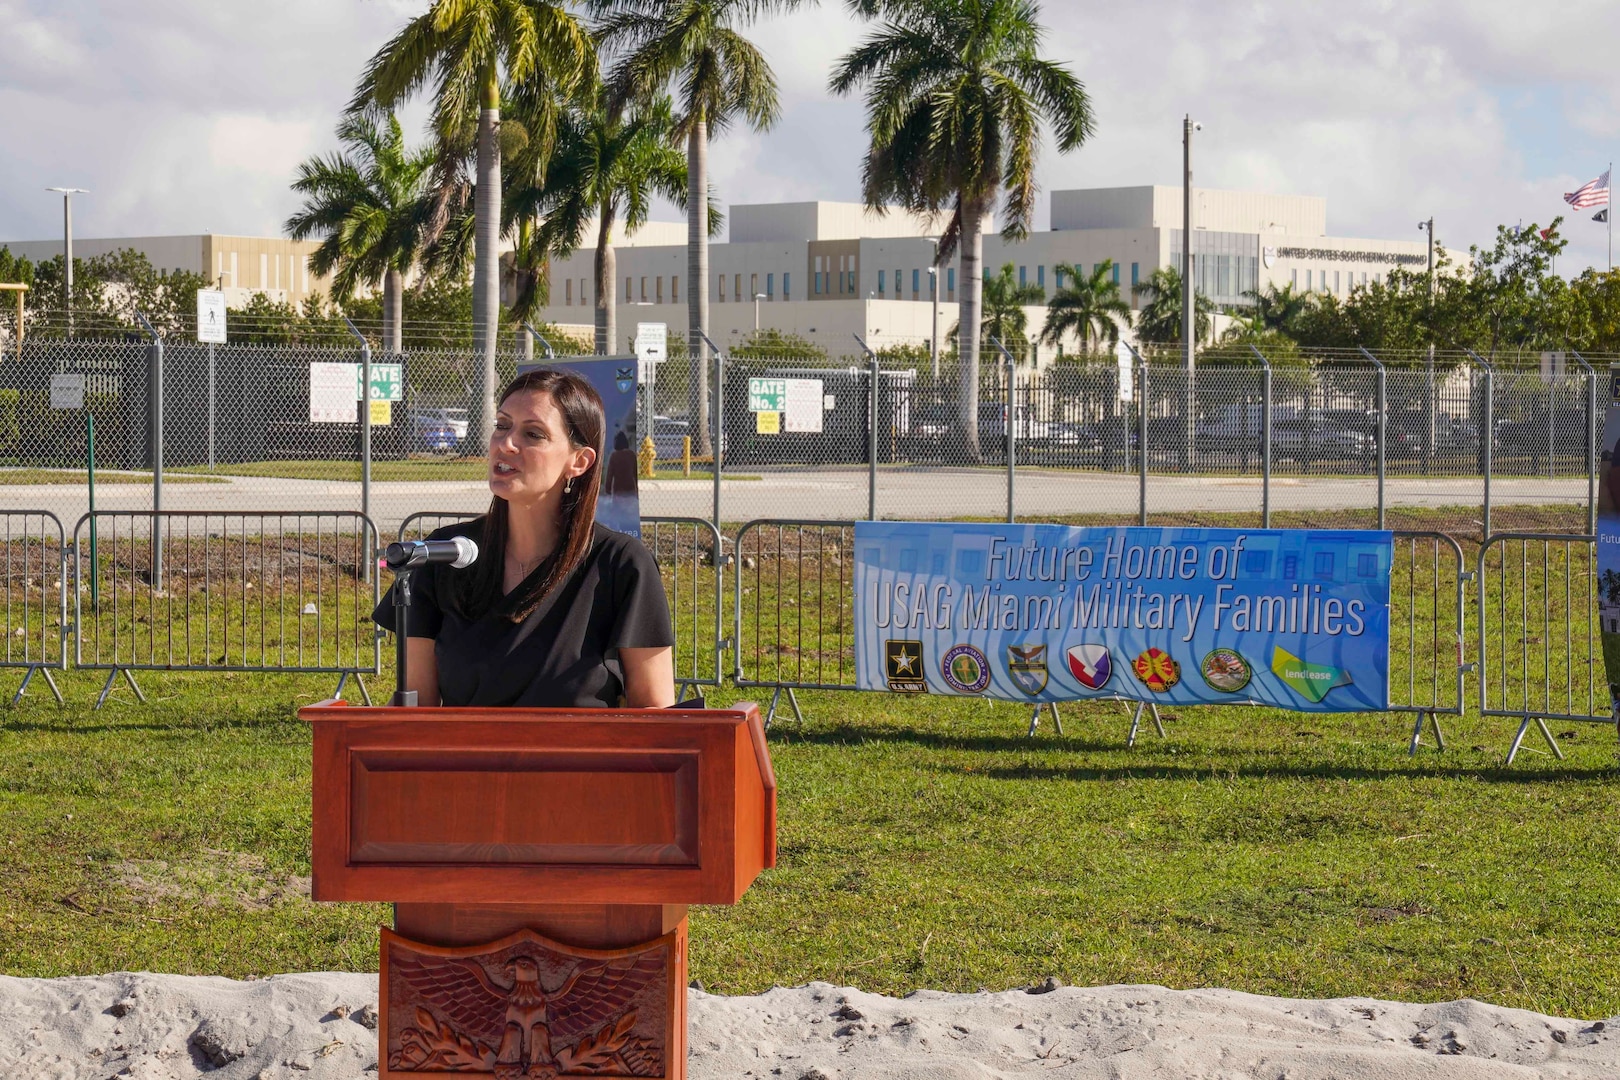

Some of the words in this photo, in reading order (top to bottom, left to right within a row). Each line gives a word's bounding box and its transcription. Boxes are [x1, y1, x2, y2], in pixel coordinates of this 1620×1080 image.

[390, 383, 399, 398] 2
[751, 381, 784, 395] GATE
[751, 395, 773, 410] No.
[776, 395, 785, 410] 2
[986, 536, 1094, 582] Future
[1101, 536, 1198, 581] Home
[1207, 535, 1247, 581] of
[873, 582, 953, 630] USAG
[962, 583, 1066, 631] Miami
[1072, 581, 1204, 642] Military
[1213, 583, 1366, 637] Families
[1285, 669, 1332, 680] lendlease
